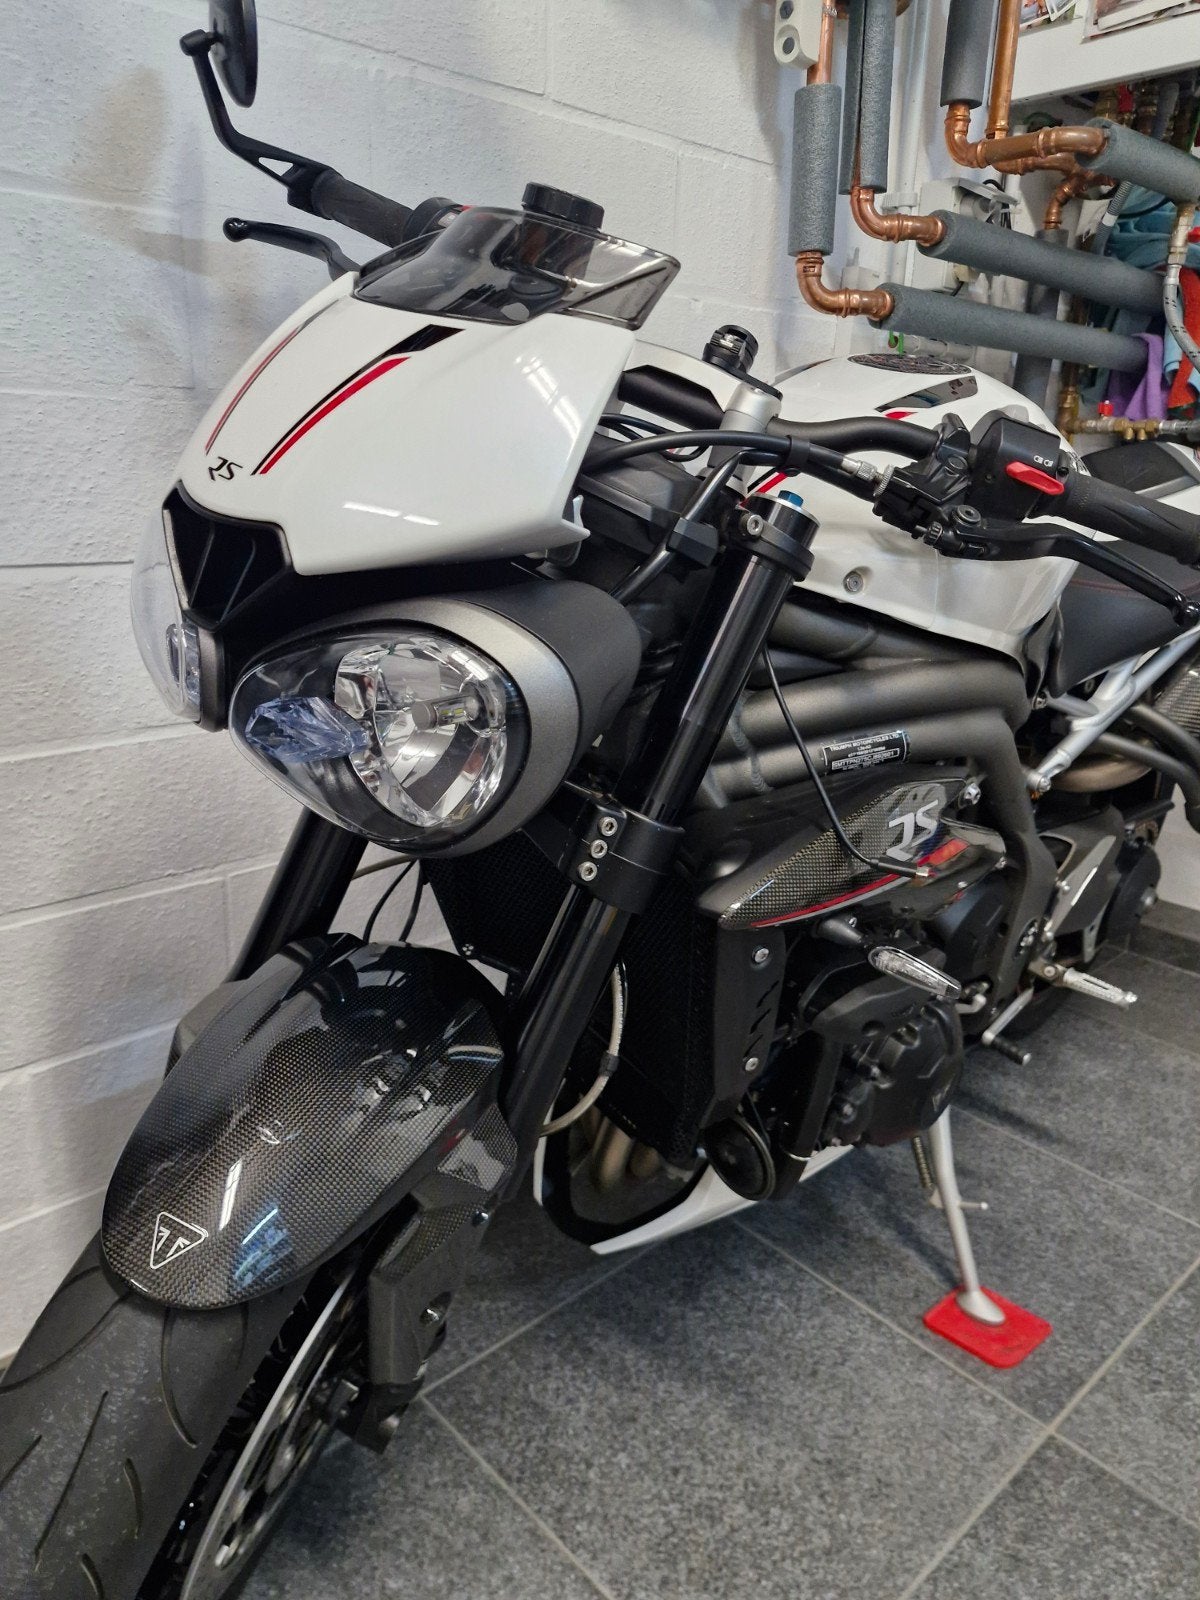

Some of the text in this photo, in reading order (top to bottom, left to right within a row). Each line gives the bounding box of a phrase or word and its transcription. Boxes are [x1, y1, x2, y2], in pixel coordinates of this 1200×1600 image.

[208, 456, 243, 481] RS
[830, 743, 852, 751] TRIUMPH
[852, 736, 889, 746] MOTORCYCLES
[886, 800, 939, 861] RS
